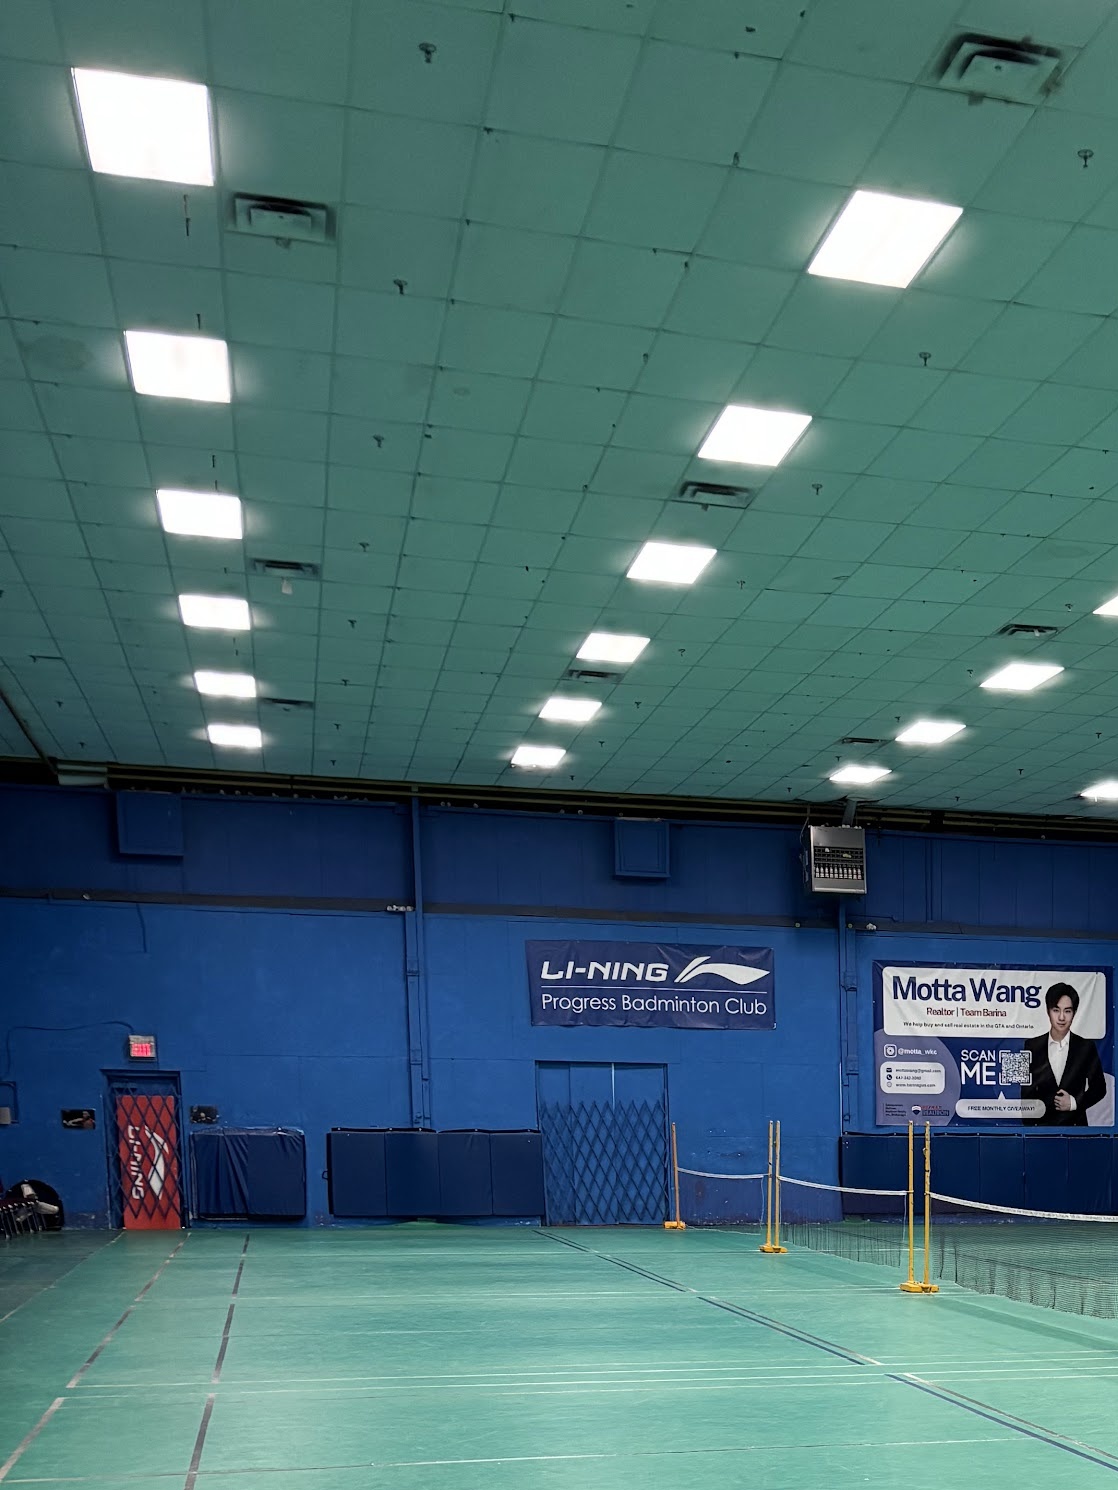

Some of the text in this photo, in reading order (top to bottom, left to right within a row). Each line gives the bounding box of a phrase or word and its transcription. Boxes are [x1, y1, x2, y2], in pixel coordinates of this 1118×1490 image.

[540, 961, 670, 982] LI-NING
[893, 975, 1042, 1008] Motta Wang
[541, 993, 767, 1015] Progress Badminton Club
[926, 1007, 955, 1016] Realtor
[960, 1008, 982, 1017] Team
[960, 1049, 996, 1061] SCAN
[960, 1061, 996, 1085] ME
